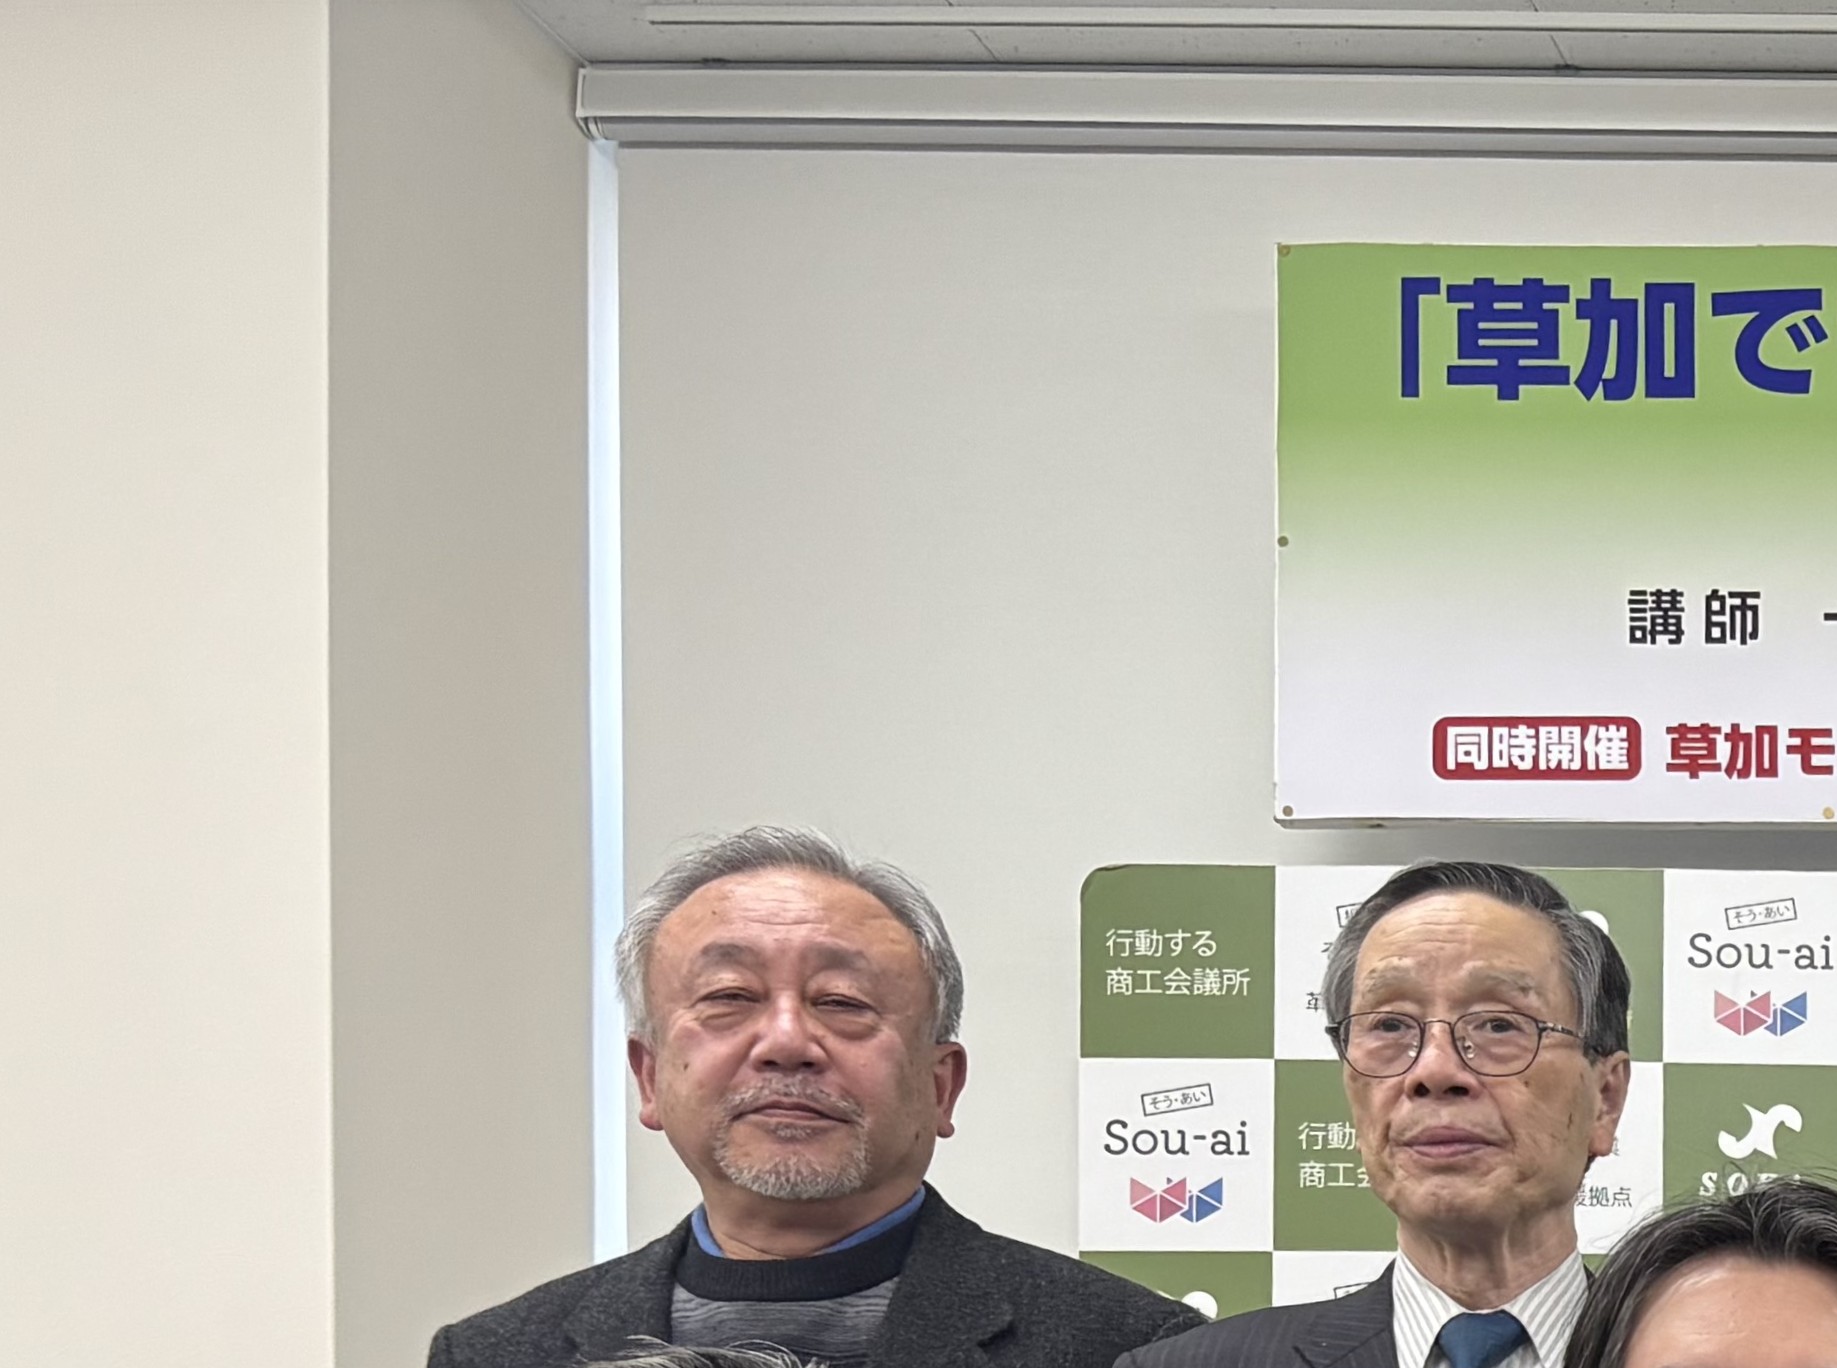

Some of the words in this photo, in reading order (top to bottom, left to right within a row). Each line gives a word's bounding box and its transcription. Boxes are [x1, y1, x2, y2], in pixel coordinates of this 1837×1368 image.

[1628, 589, 1760, 645] 講師
[1445, 729, 1630, 771] 同時開催
[1106, 929, 1216, 957] 行動する
[1688, 933, 1833, 970] Sou-ai
[1106, 967, 1250, 996] 商工会議所
[1104, 1119, 1249, 1155] Sou-ai
